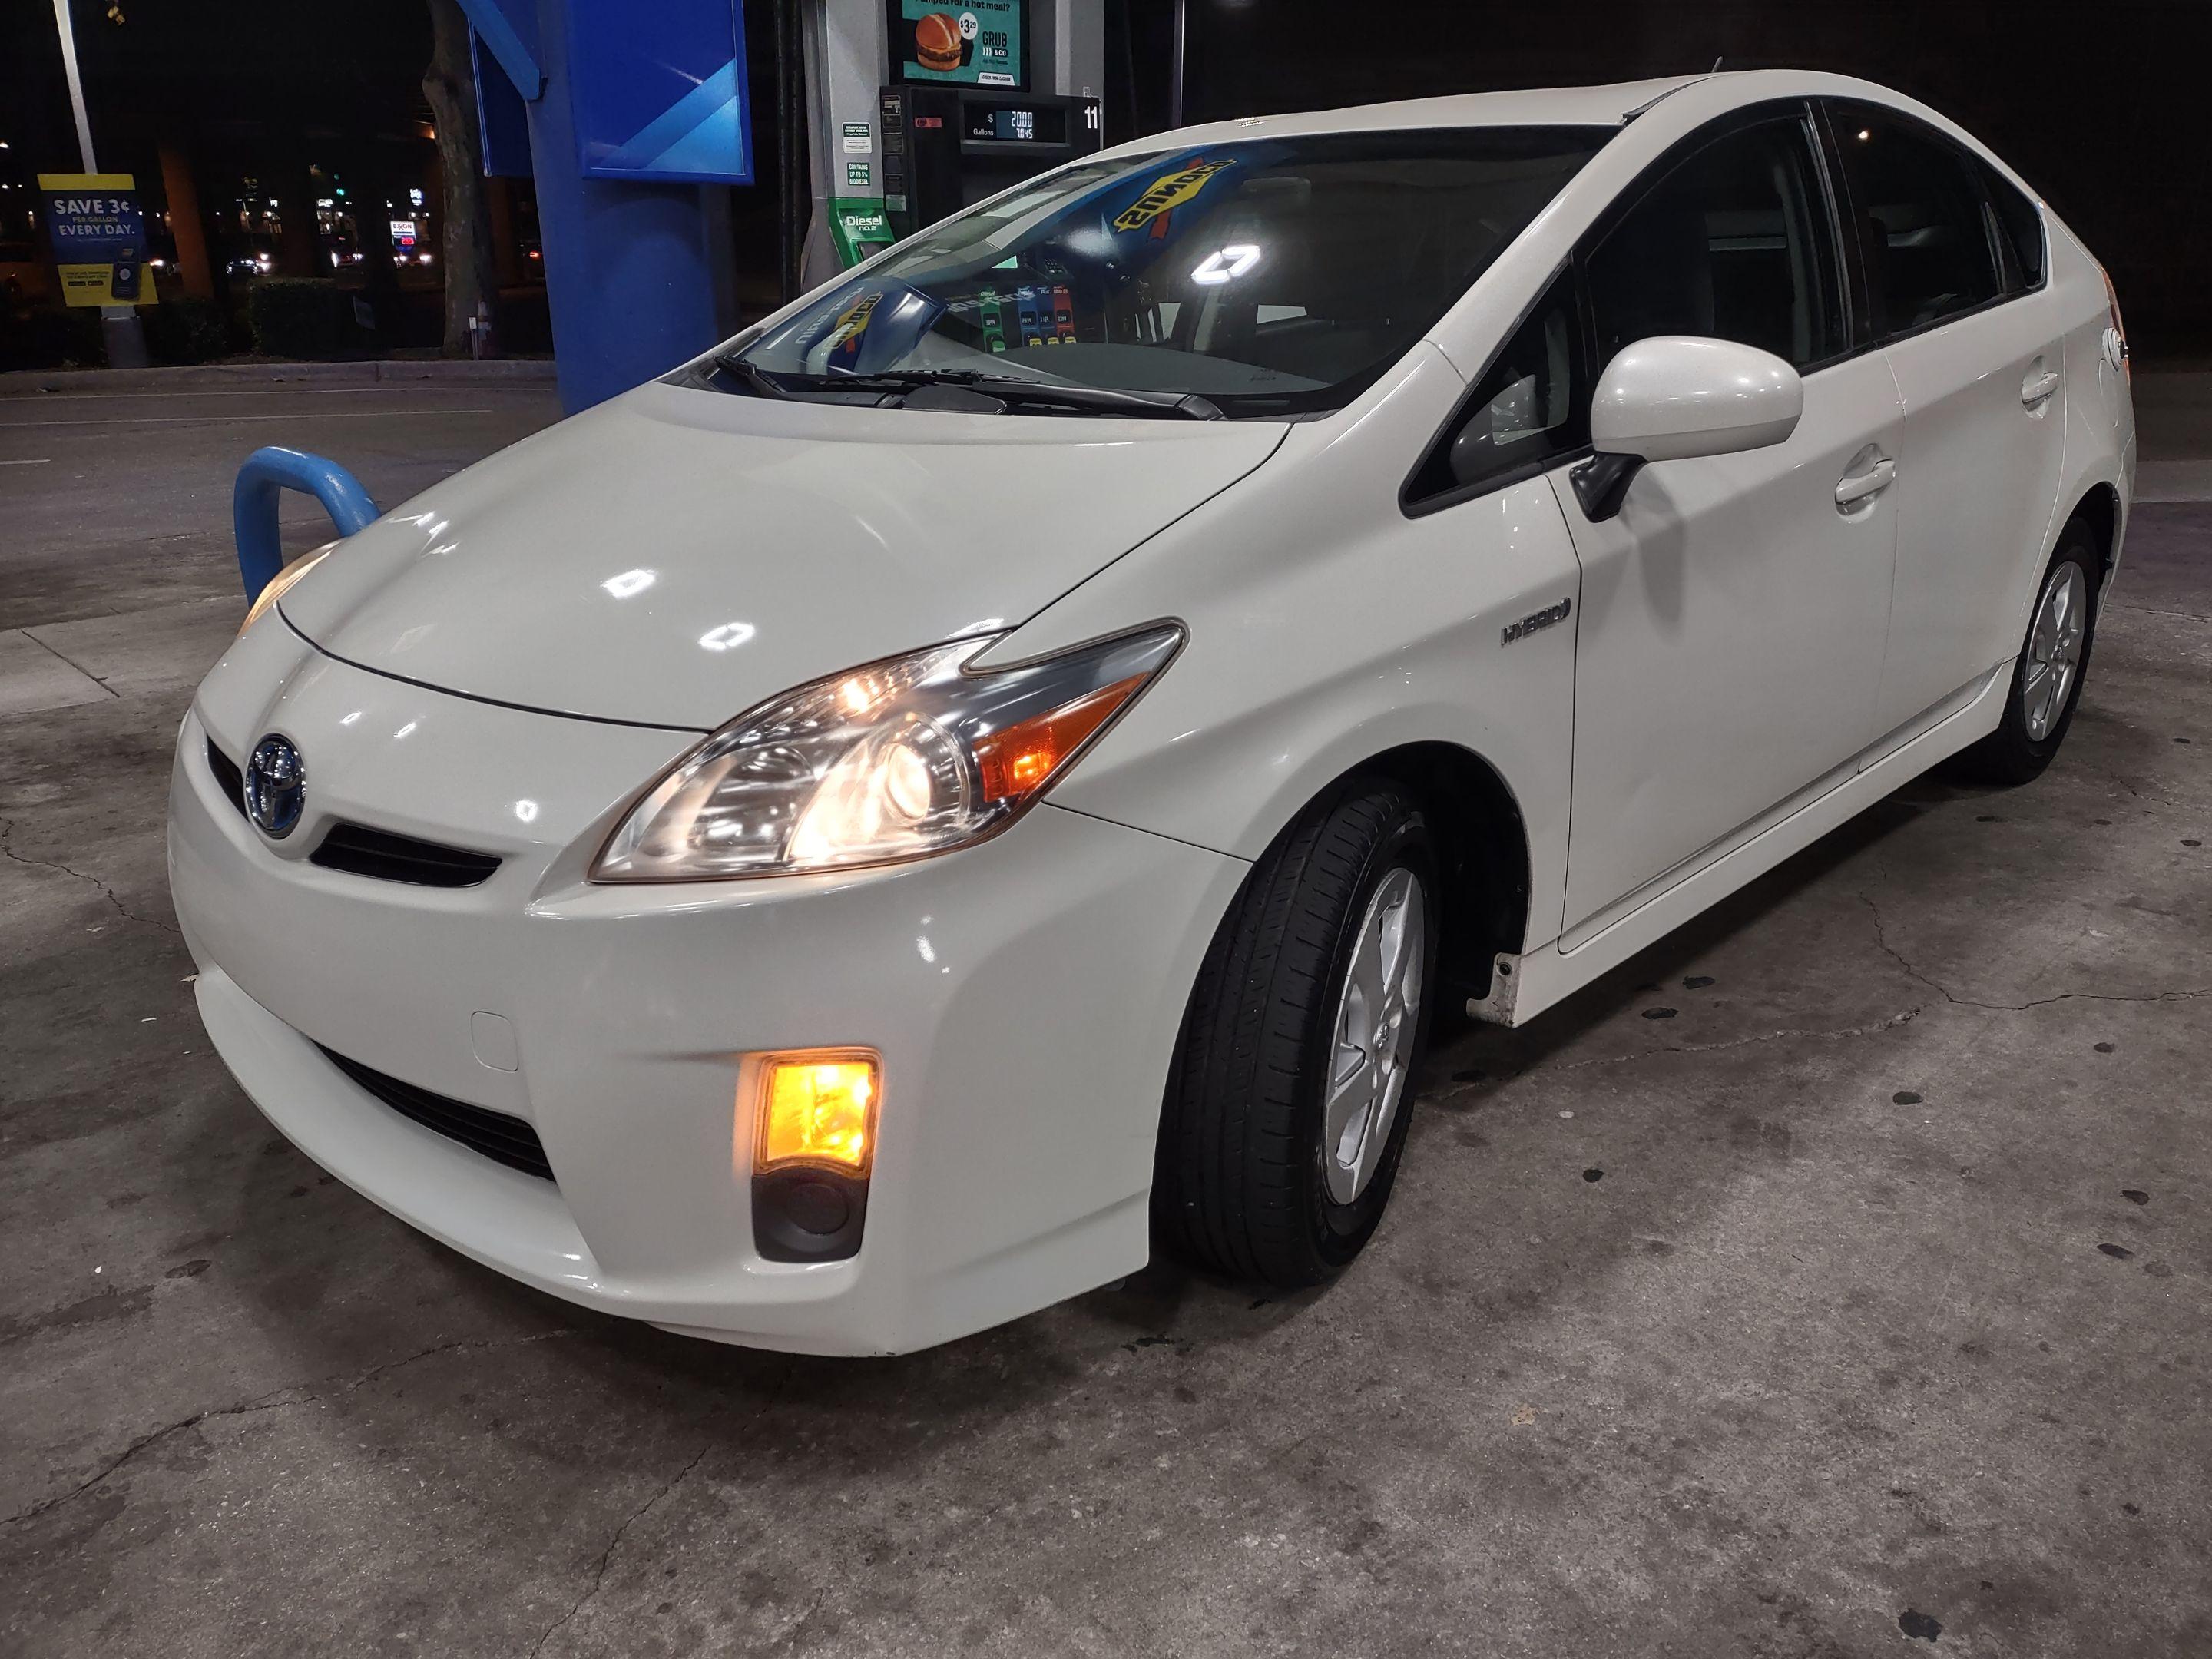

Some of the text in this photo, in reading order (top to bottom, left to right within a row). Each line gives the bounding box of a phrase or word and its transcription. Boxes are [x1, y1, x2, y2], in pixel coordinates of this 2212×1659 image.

[971, 1, 985, 9] hot
[986, 2, 1011, 12] meal?
[982, 31, 1008, 48] GRUB
[988, 114, 993, 123] $
[1084, 105, 1098, 129] 11
[54, 199, 130, 214] SAVE 3¢
[846, 215, 882, 226] Diesel
[58, 224, 135, 236] EVERY DAY.
[1501, 598, 1571, 647] HYBRID
